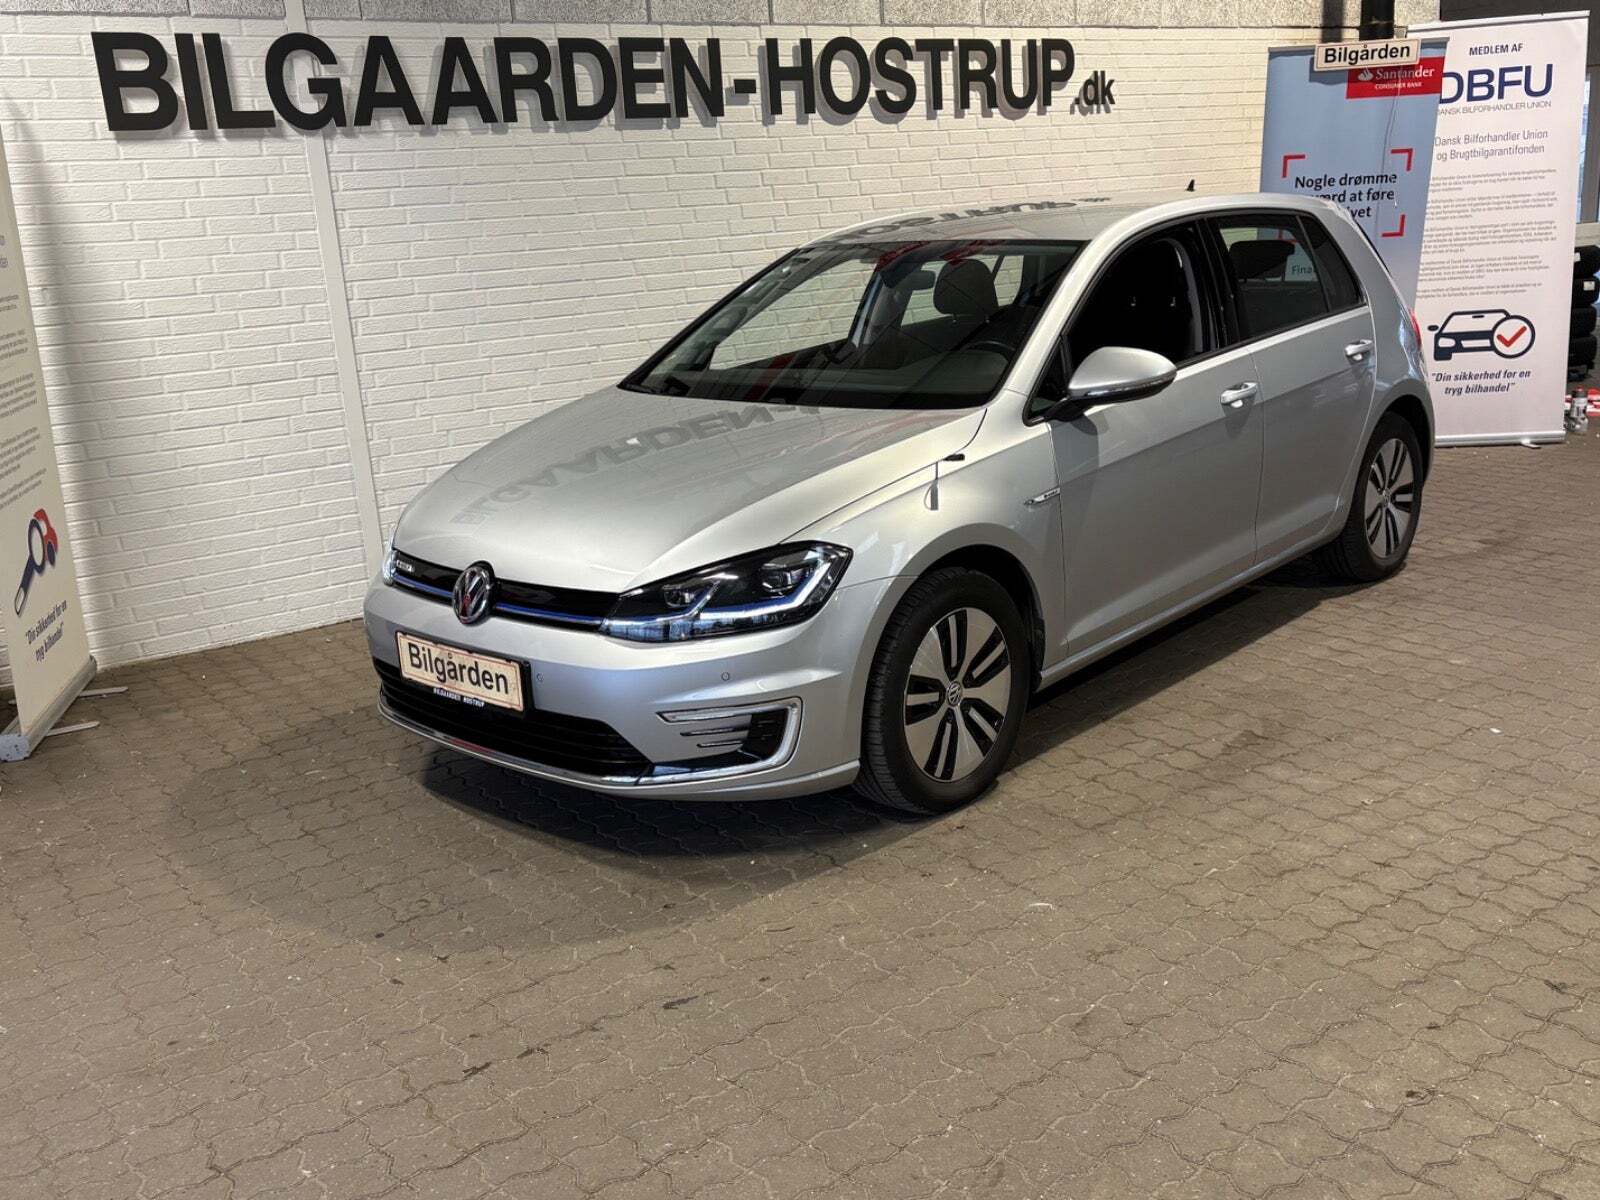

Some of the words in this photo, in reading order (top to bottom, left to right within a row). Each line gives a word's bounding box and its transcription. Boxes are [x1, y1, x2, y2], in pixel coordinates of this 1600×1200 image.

[1324, 43, 1410, 66] Bilgården
[1469, 45, 1509, 56] MEDLEM
[1511, 43, 1524, 53] AF
[1376, 65, 1435, 80] Santander
[1439, 64, 1553, 104] DBFU
[1437, 108, 1461, 116] ANSK
[1462, 102, 1526, 114] BILFORHANDLER
[1527, 100, 1552, 109] UNION
[1434, 136, 1462, 147] Dansk
[1464, 130, 1520, 145] Bilforhandler
[1523, 129, 1549, 140] Union
[1436, 152, 1448, 162] og
[1450, 145, 1545, 161] Brugtbilgarantifonden
[1295, 174, 1336, 191] Nogle
[1339, 173, 1398, 186] drømme
[1350, 190, 1363, 202] at
[1367, 187, 1395, 201] føre
[1454, 370, 1502, 381] sikkerhed
[1503, 369, 1517, 379] for
[1519, 370, 1531, 378] en
[1445, 386, 1463, 396] tryg
[407, 642, 509, 695] Bilgården
